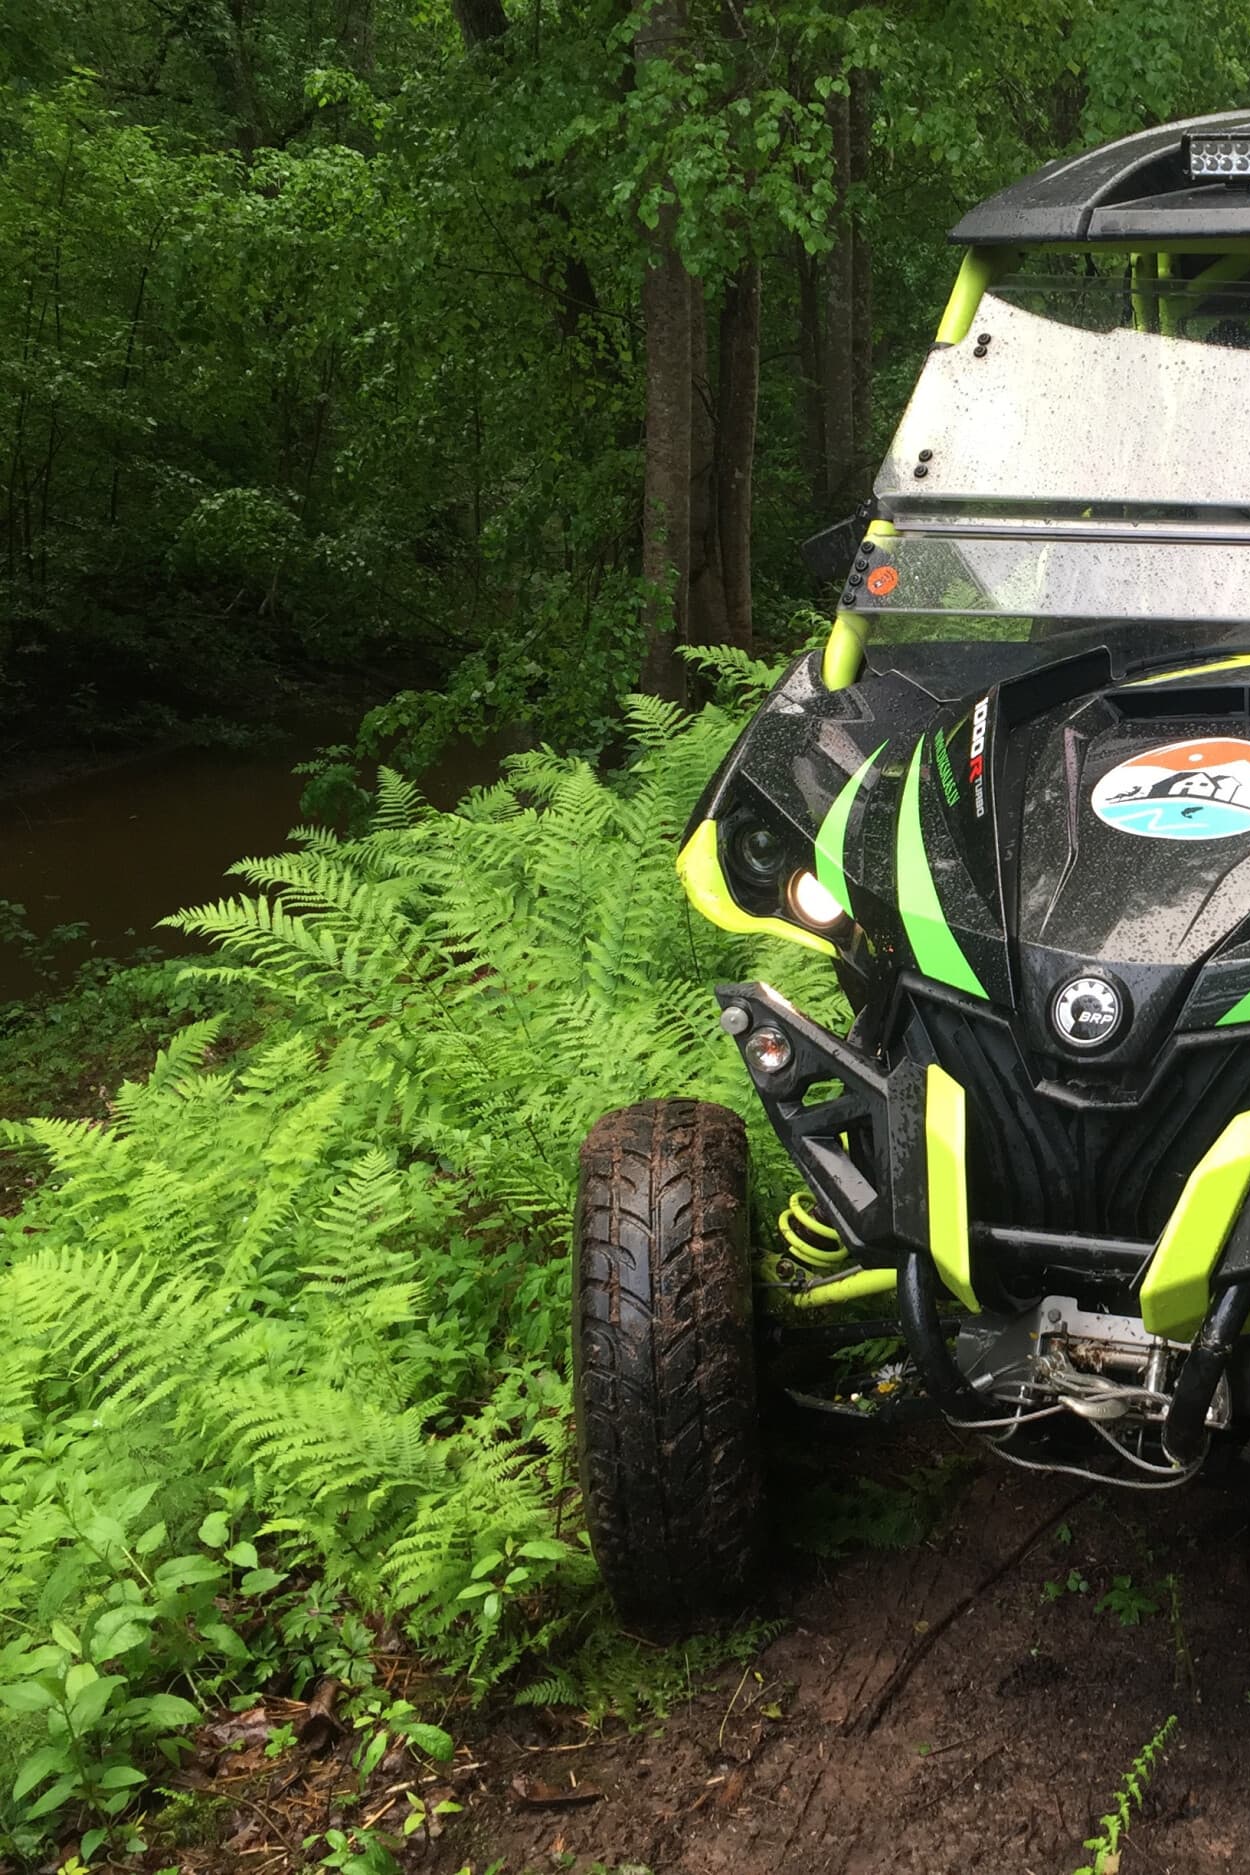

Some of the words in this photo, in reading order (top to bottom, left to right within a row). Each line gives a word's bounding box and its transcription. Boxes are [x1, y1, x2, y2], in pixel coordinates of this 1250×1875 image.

[970, 697, 988, 782] 1000R
[974, 775, 985, 817] TURBO
[1079, 1011, 1113, 1024] BRP
